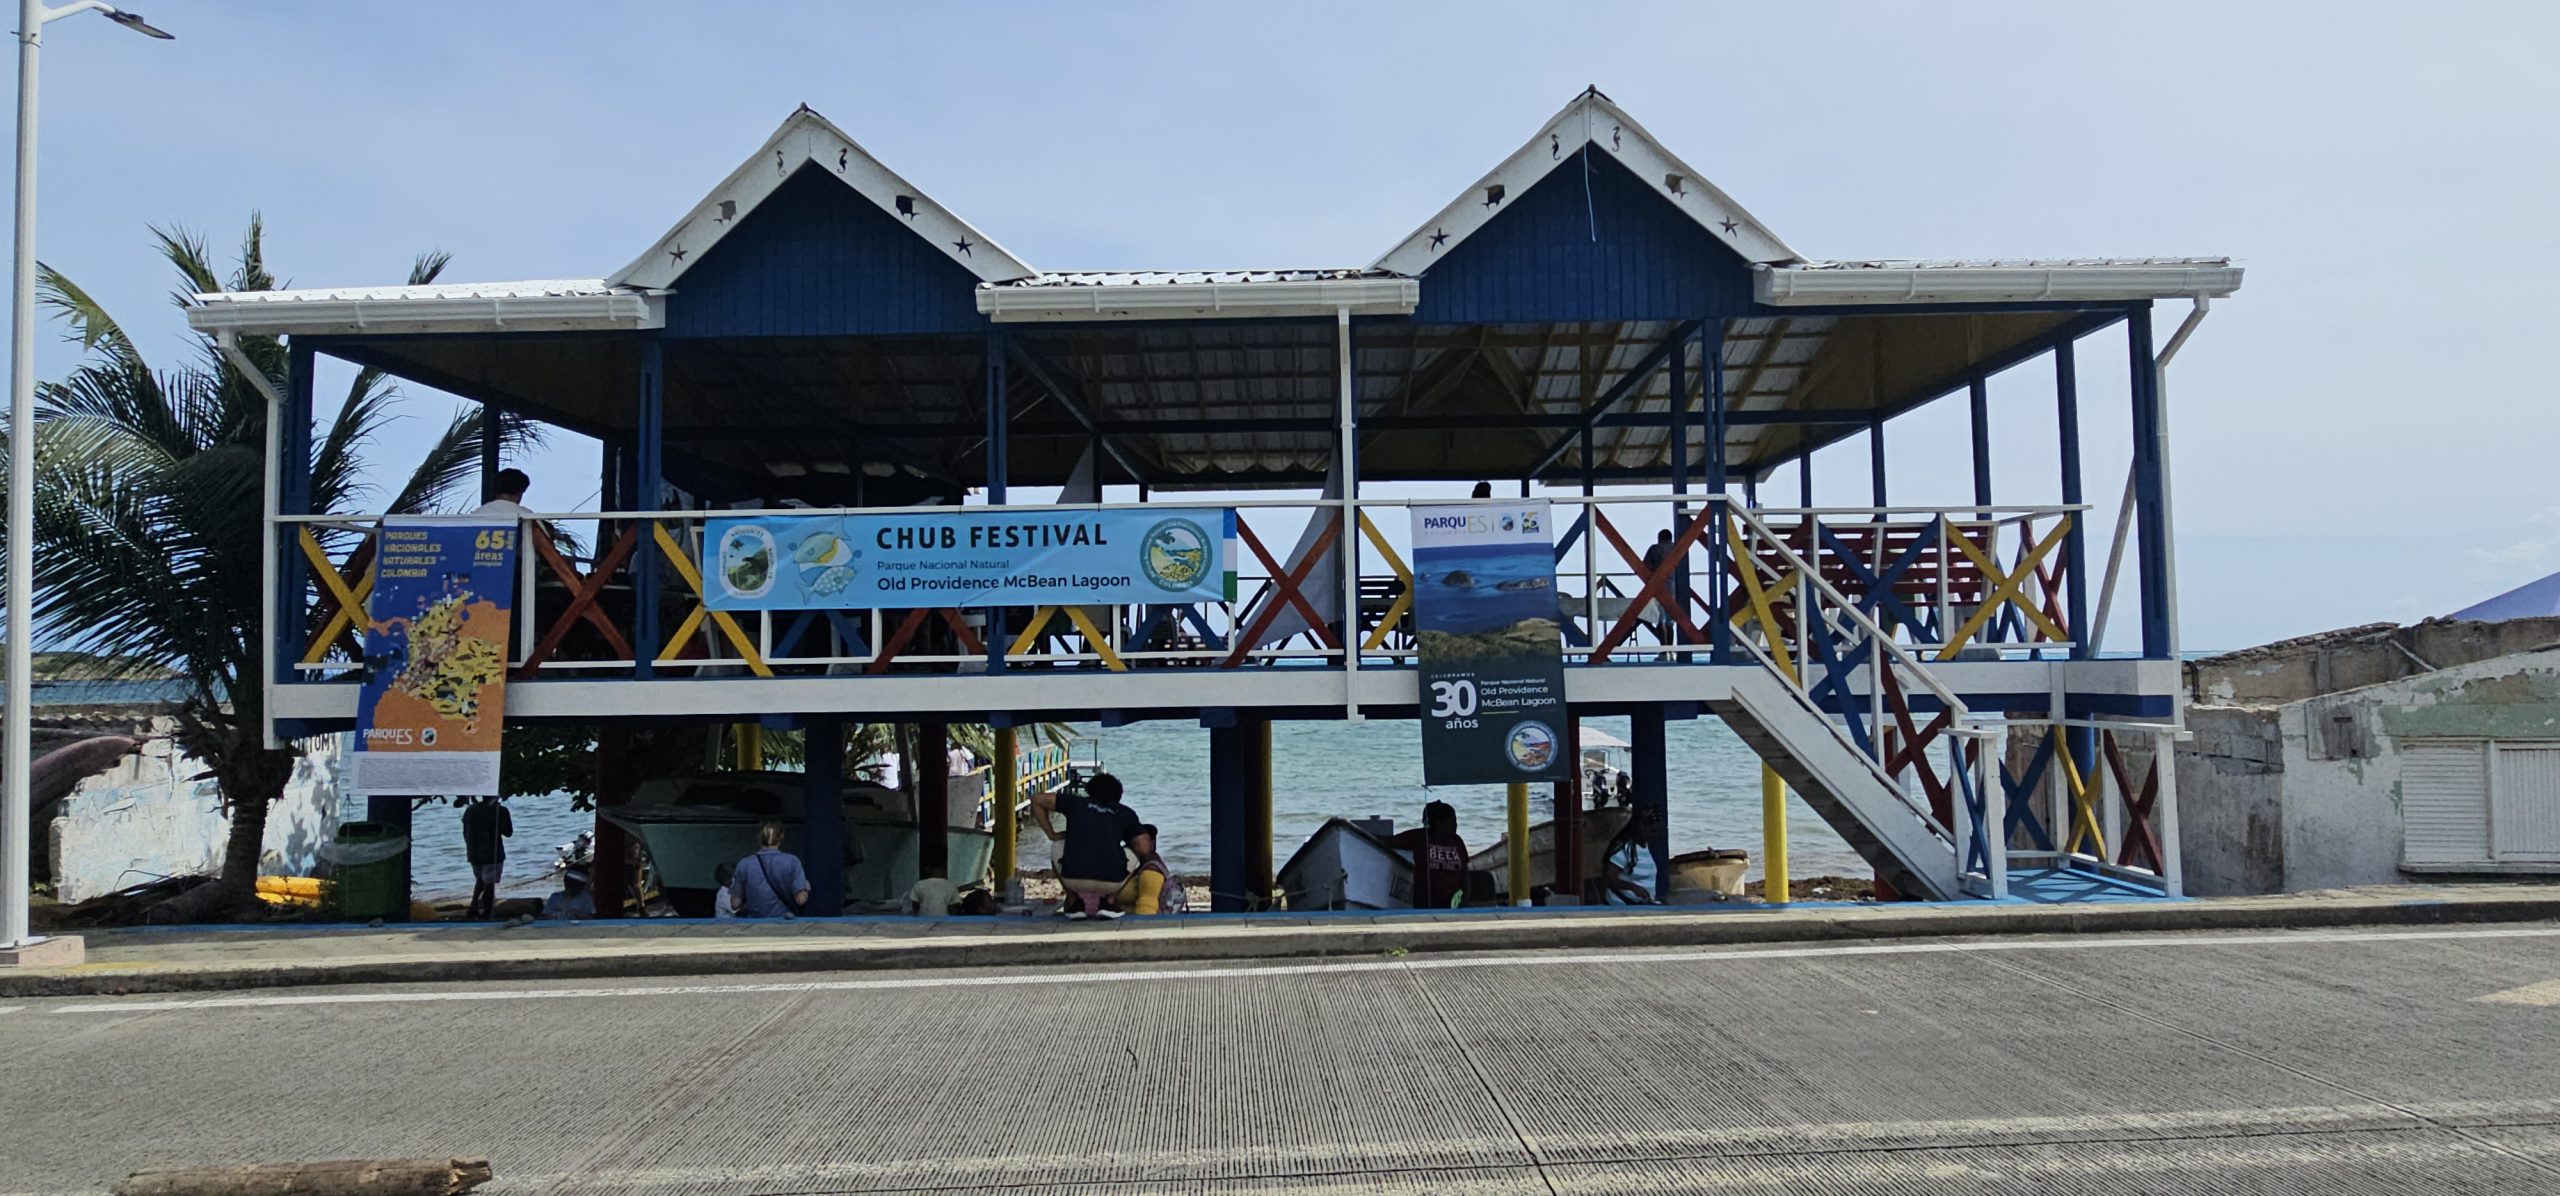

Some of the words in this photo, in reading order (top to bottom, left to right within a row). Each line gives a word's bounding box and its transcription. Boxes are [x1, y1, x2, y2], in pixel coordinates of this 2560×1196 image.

[1424, 515, 1487, 533] PARQUES
[385, 531, 428, 540] PARQUES
[475, 530, 505, 550] 65
[876, 526, 956, 549] CHUB
[970, 523, 1107, 548] FESTIVAL
[383, 543, 442, 552] NACIONALES
[382, 556, 436, 565] NATURALES
[474, 550, 503, 560] áreas
[877, 561, 916, 571] Parque
[920, 560, 967, 570] Nacional
[970, 559, 1010, 569] Natural
[381, 568, 428, 578] COLOMBIA
[877, 576, 906, 591] Old
[911, 576, 999, 590] Providence
[1004, 575, 1067, 588] McBean
[1072, 574, 1130, 590] Lagoon
[1481, 687, 1496, 695] Old
[1499, 686, 1548, 695] Providence
[1430, 680, 1477, 717] 30
[1482, 699, 1519, 707] McBean
[1522, 697, 1556, 707] Lagoon
[1445, 717, 1479, 729] años
[362, 728, 412, 744] PARQUES
[1430, 847, 1460, 861] BEER
